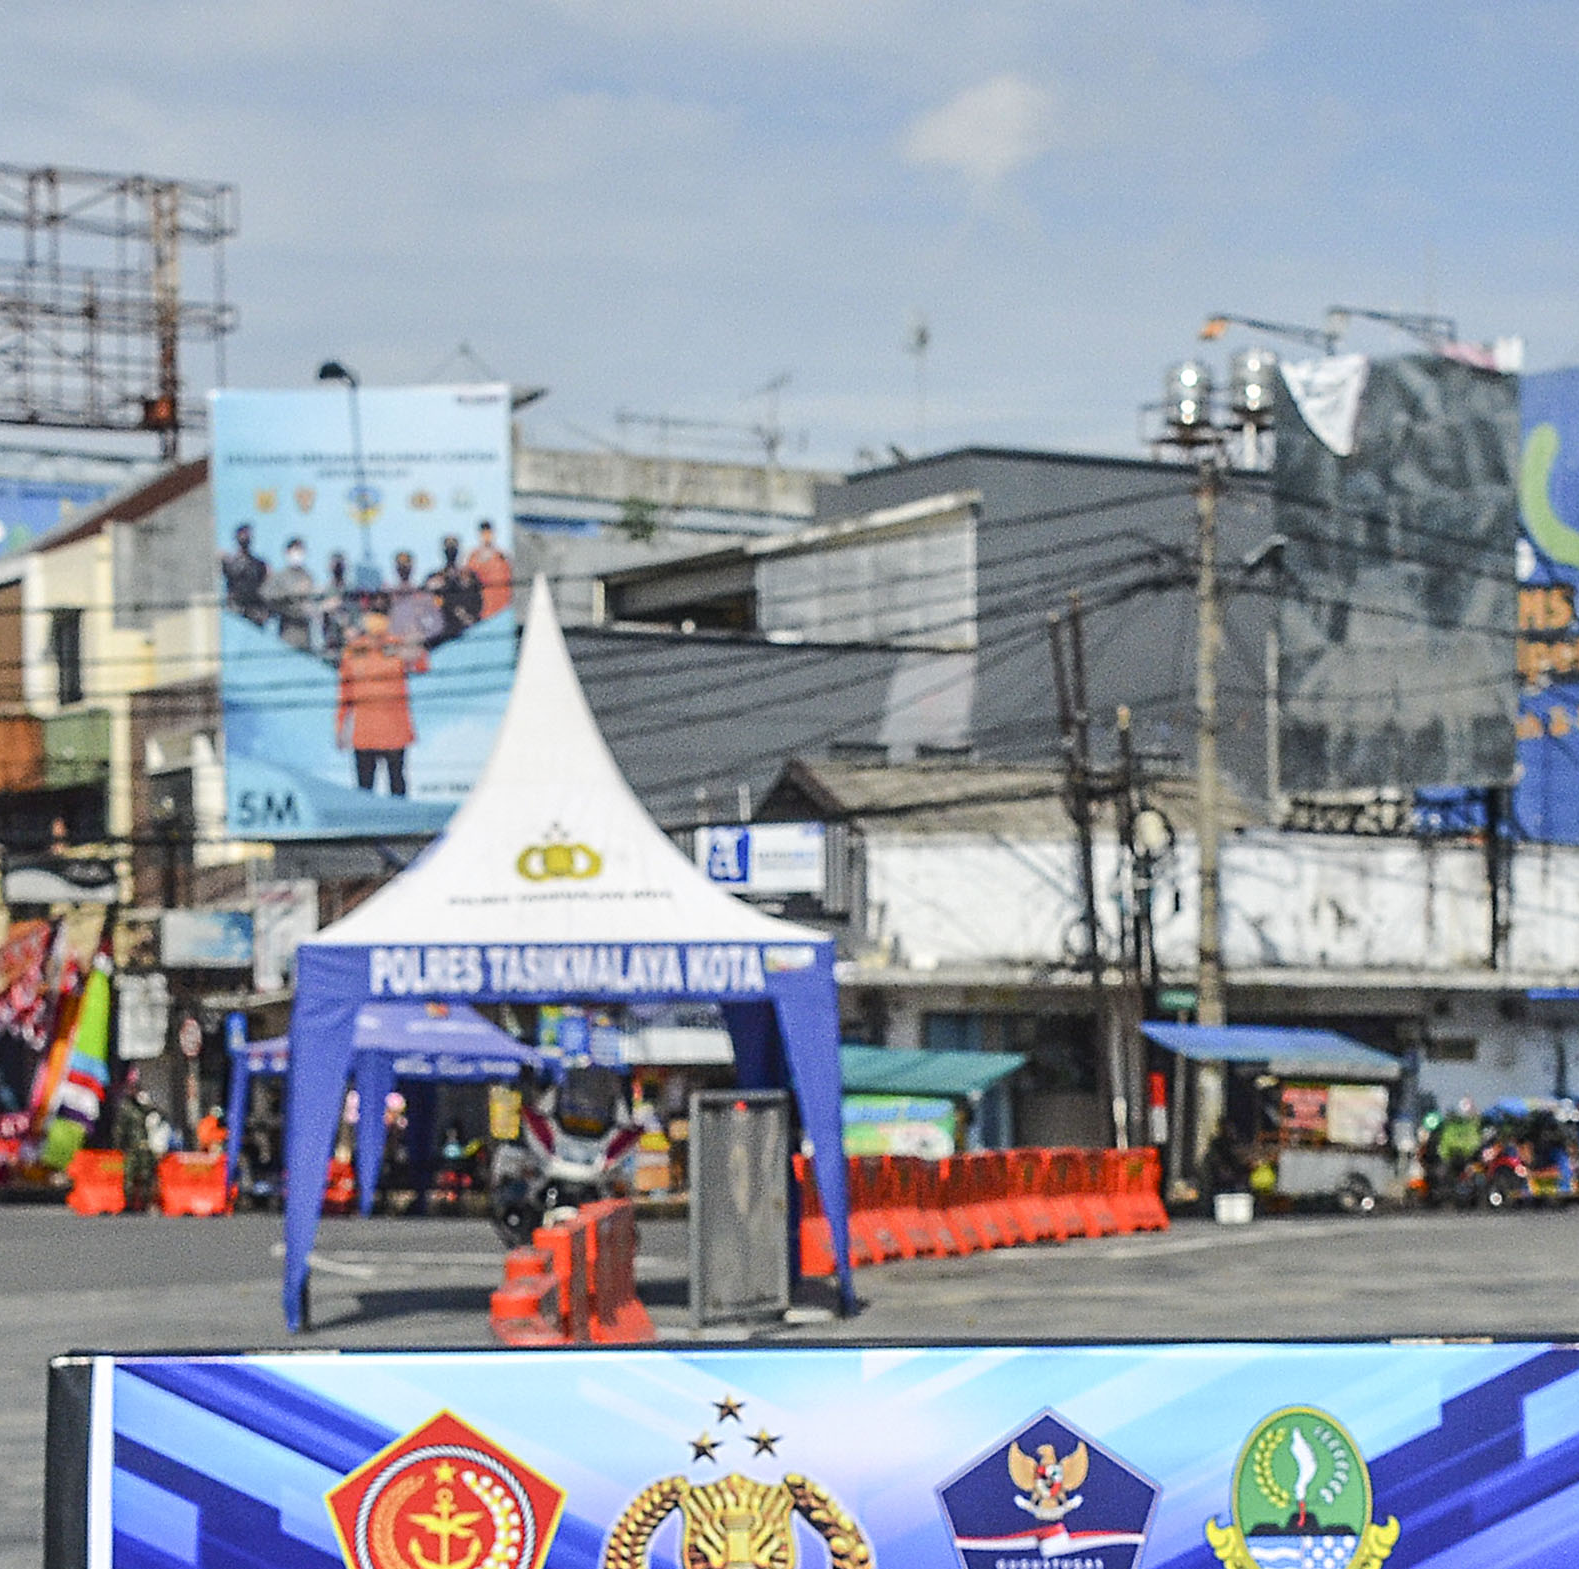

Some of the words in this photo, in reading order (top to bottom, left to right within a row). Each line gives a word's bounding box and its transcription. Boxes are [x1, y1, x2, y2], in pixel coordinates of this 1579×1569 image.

[370, 946, 482, 993] POLRES
[490, 946, 684, 992] TASIKMALAYA
[686, 946, 766, 991] KOTA
